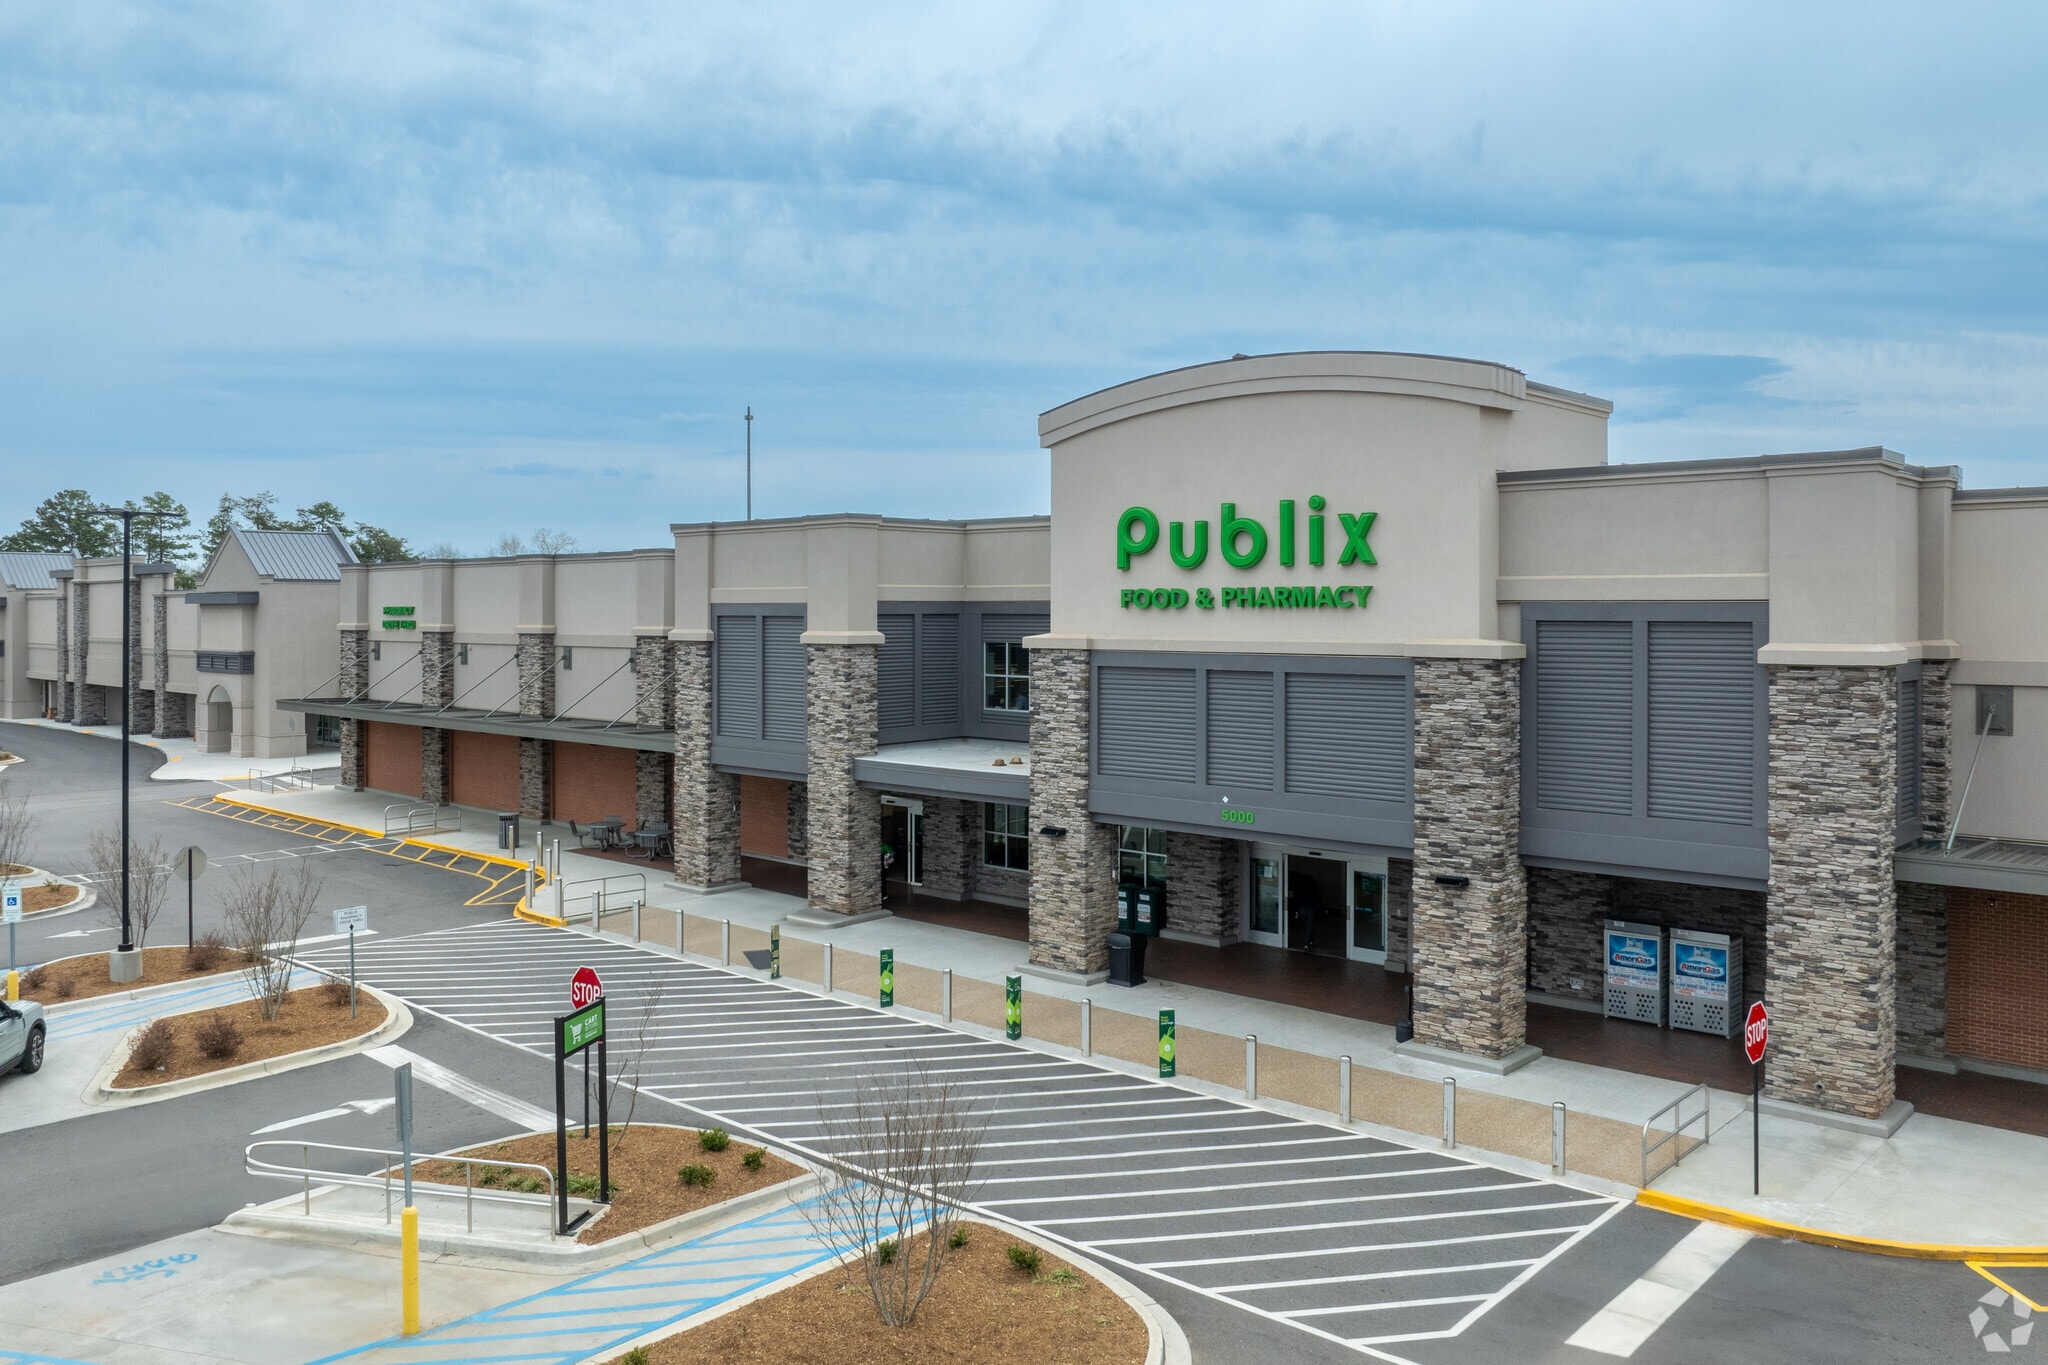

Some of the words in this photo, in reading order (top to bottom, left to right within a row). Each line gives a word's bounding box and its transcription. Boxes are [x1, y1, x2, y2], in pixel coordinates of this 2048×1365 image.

[1116, 495, 1379, 571] Publix
[1120, 588, 1190, 609] FOOD
[1195, 588, 1215, 609] &
[1221, 585, 1374, 609] PHARMACY
[1222, 809, 1255, 825] 5000
[1614, 953, 1652, 964] AmeriGas
[1681, 963, 1721, 974] AmeriGas
[573, 981, 601, 1003] STOP
[584, 1014, 598, 1025] CART
[1747, 1018, 1767, 1047] STOP
